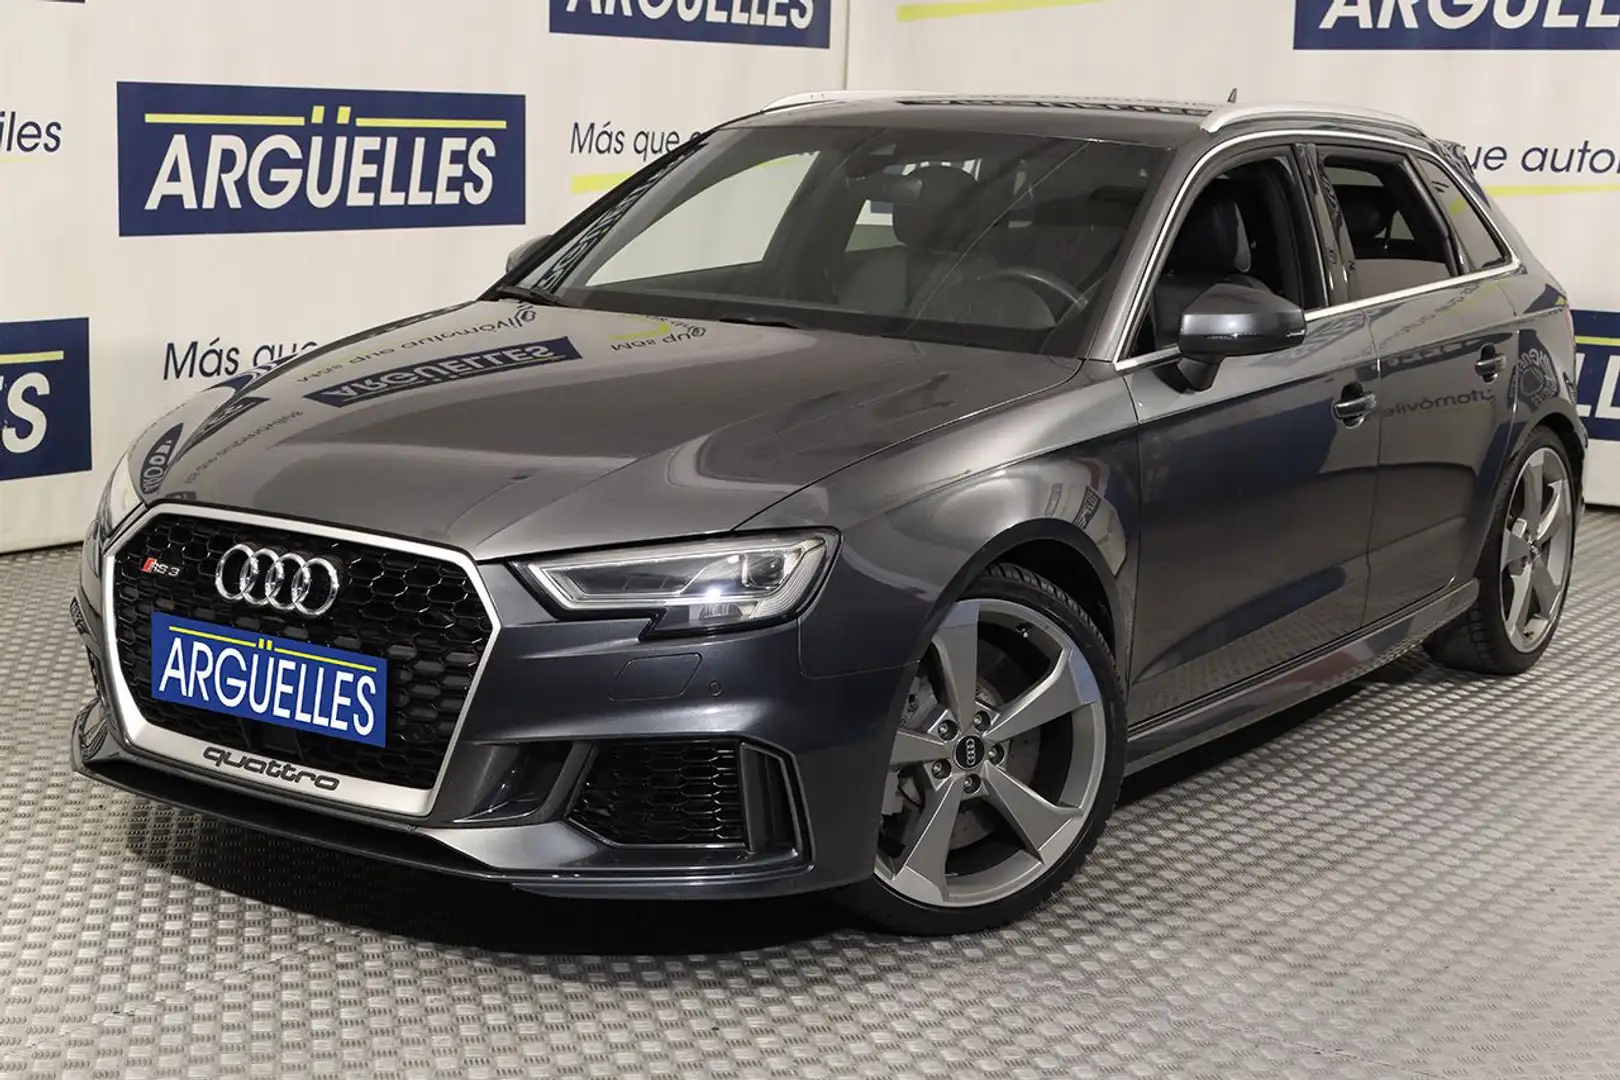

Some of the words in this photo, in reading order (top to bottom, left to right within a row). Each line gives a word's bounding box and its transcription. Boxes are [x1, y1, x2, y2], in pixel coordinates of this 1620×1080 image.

[144, 105, 497, 210] ARGÜELLES
[570, 121, 625, 155] Más
[633, 130, 680, 162] que
[1521, 140, 1620, 174] auto
[163, 337, 240, 380] Más
[158, 637, 377, 736] ARGÜELLES
[202, 745, 340, 791] quattro
